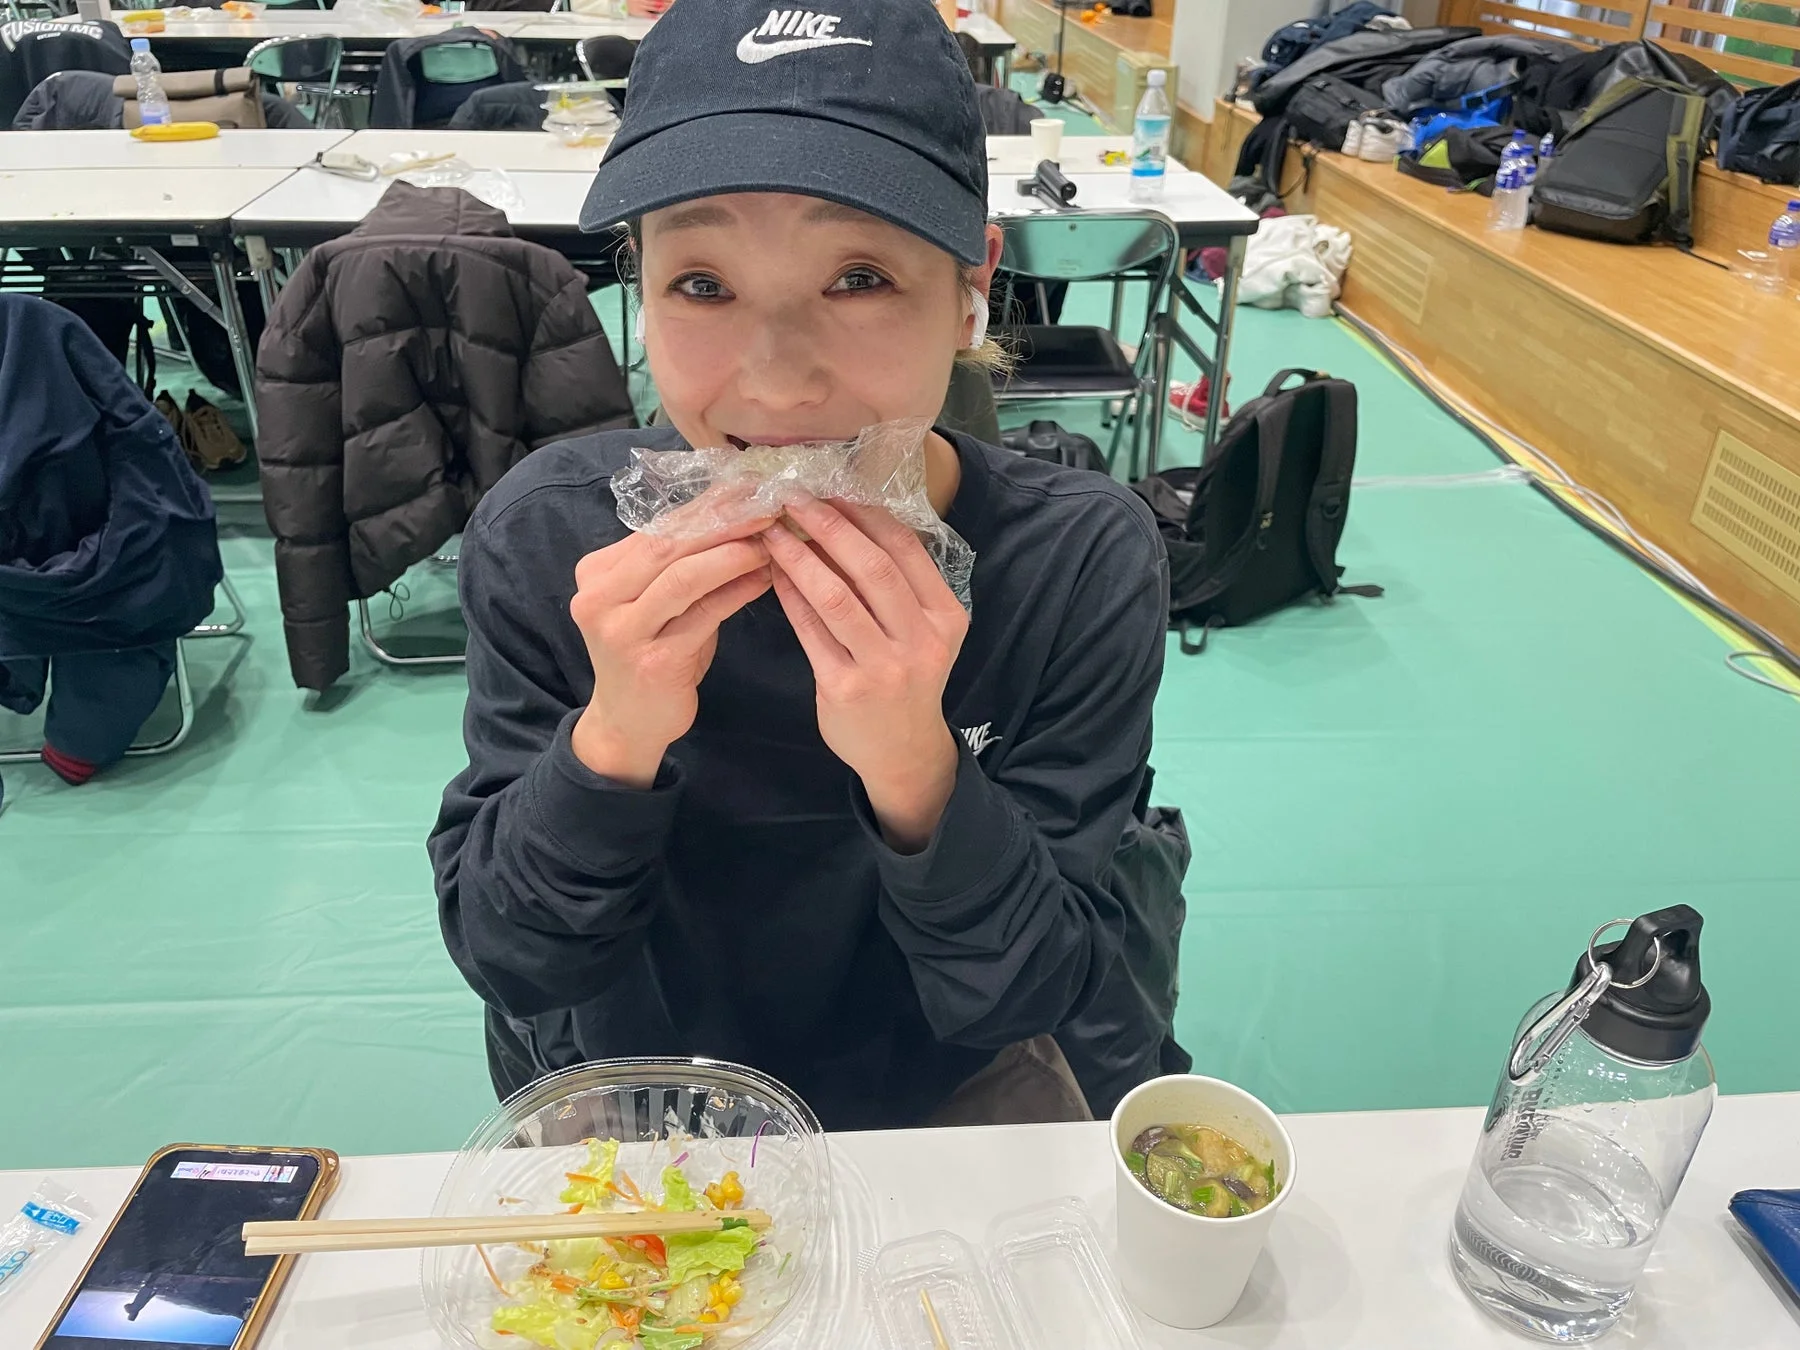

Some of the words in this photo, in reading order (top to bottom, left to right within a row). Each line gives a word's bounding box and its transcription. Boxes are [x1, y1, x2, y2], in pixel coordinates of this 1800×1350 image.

[0, 20, 69, 52] FUSION
[756, 9, 841, 39] NIKE
[960, 721, 992, 750] IKE
